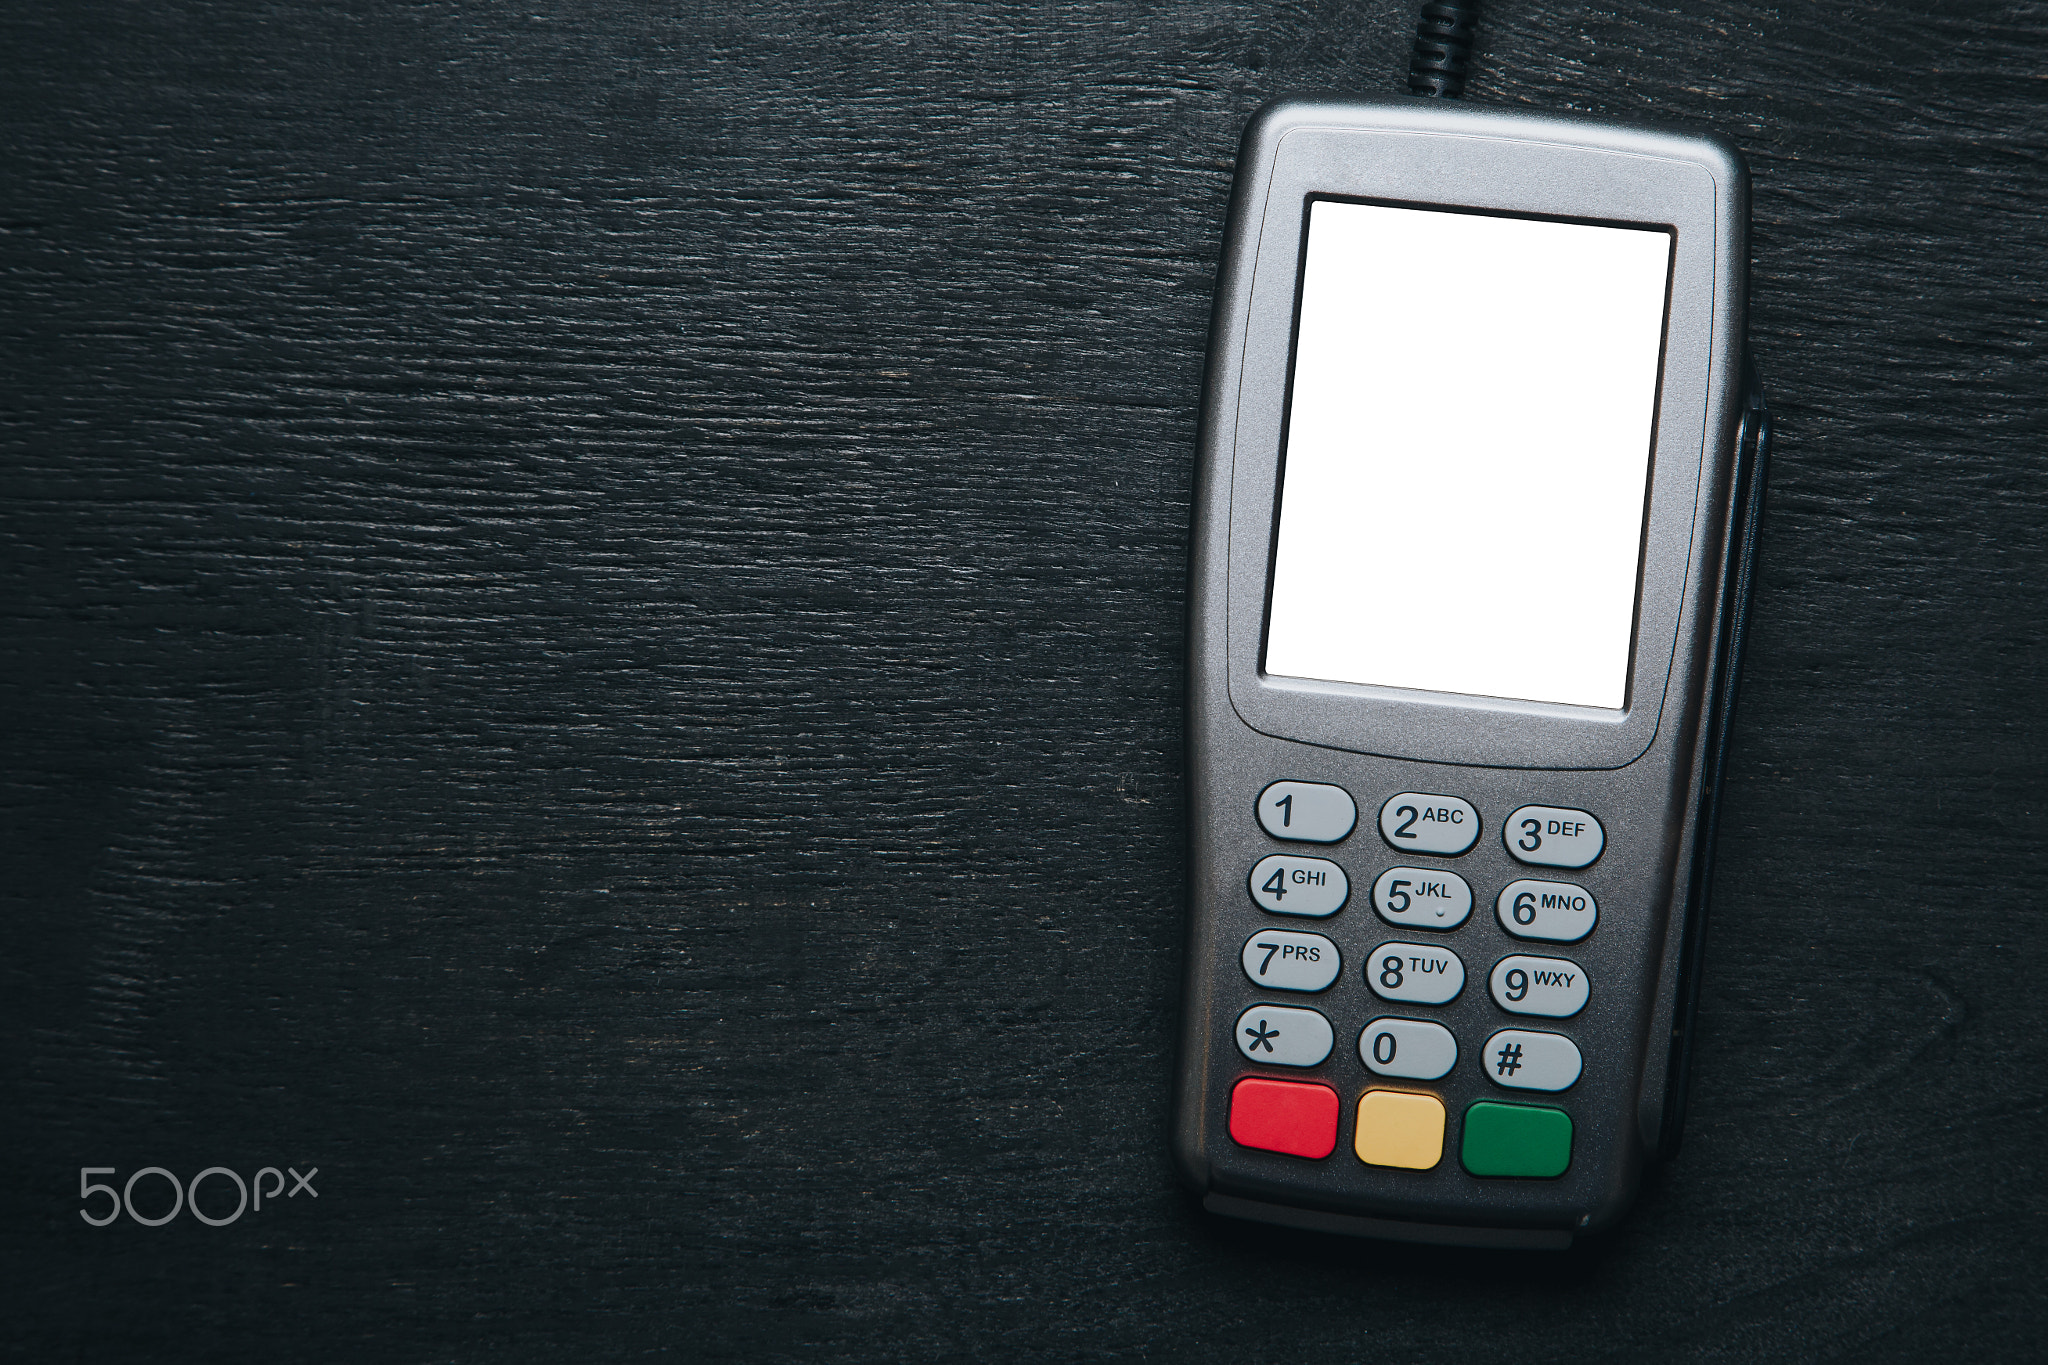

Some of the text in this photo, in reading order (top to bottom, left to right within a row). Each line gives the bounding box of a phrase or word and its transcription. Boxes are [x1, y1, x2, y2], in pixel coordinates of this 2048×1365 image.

[1275, 794, 1293, 828] 1
[1394, 805, 1464, 839] 2 ABC
[1518, 818, 1586, 852] 3 DEF
[1261, 867, 1326, 902] 4 GHI
[1387, 879, 1452, 913] 5 JKL
[1512, 892, 1586, 926] 6 MNO
[1256, 942, 1321, 976] 7 PRS
[1379, 955, 1449, 989] 8 TUV
[1505, 968, 1576, 1002] 9 WXY
